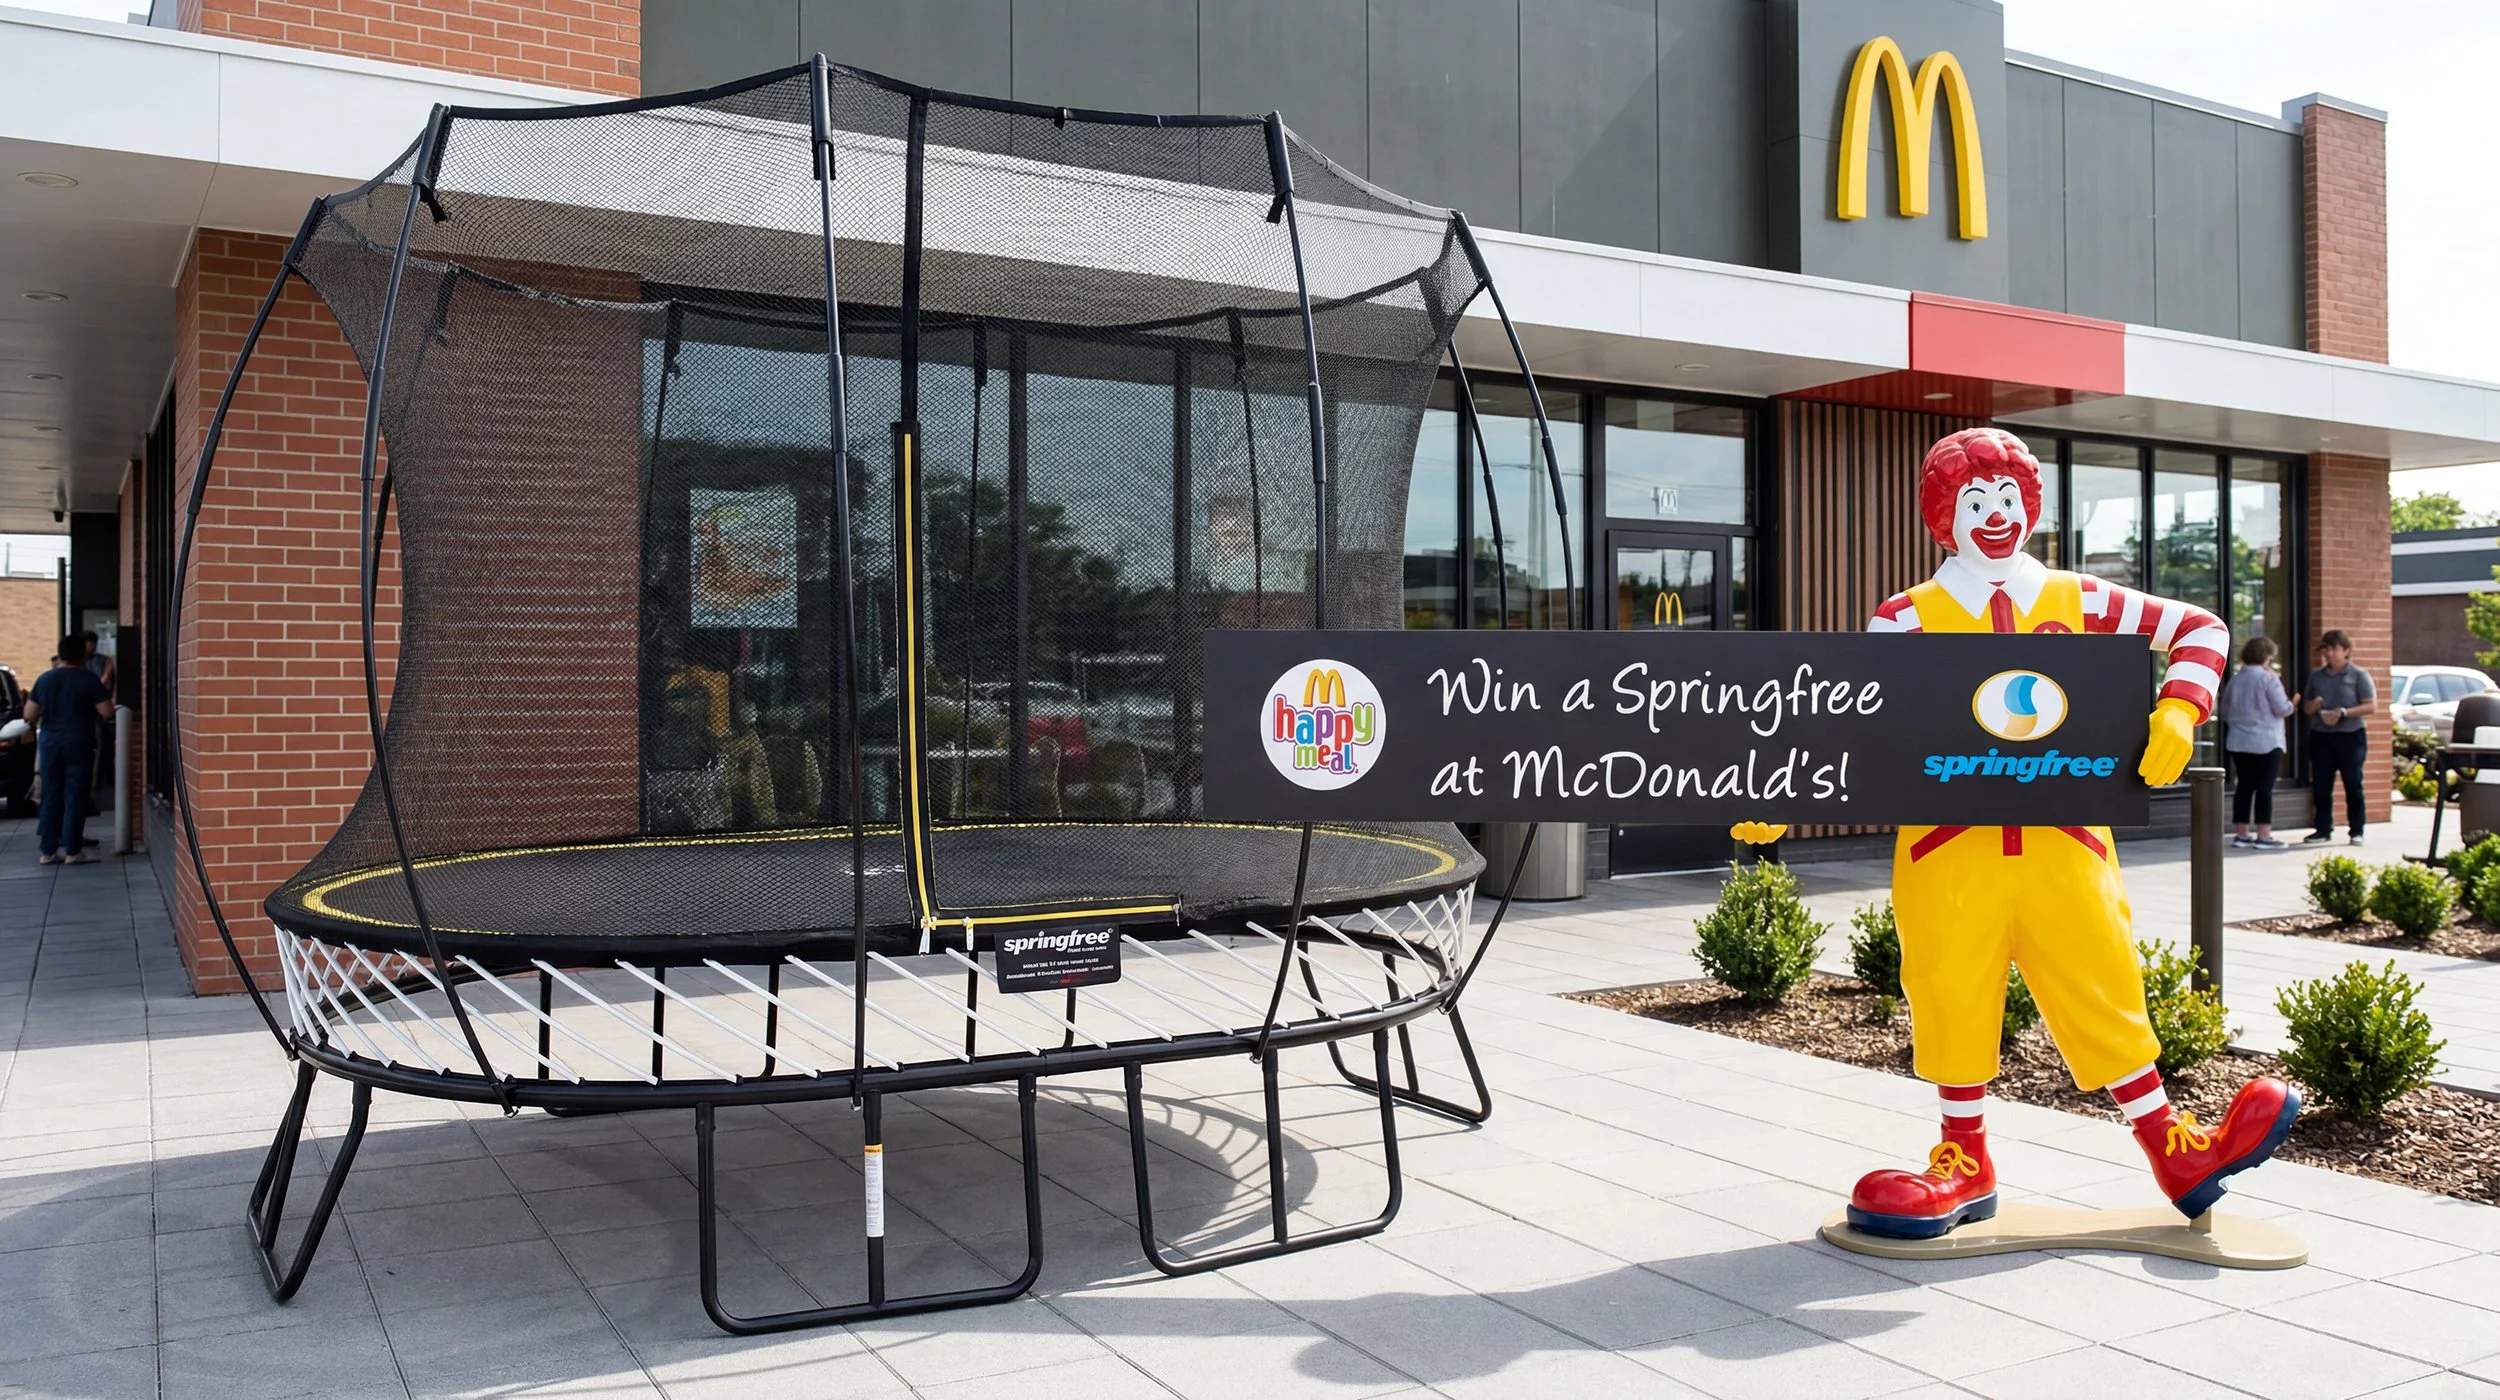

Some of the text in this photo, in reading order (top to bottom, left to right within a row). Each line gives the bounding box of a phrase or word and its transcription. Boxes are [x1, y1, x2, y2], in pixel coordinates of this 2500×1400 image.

[1426, 657, 1884, 737] Win a Springfree
[1275, 696, 1375, 751] happy
[1295, 744, 1354, 772] meal
[1430, 745, 1849, 802] at McDonald's!
[1923, 747, 2115, 784] springfree
[1003, 929, 1110, 956] springfree
